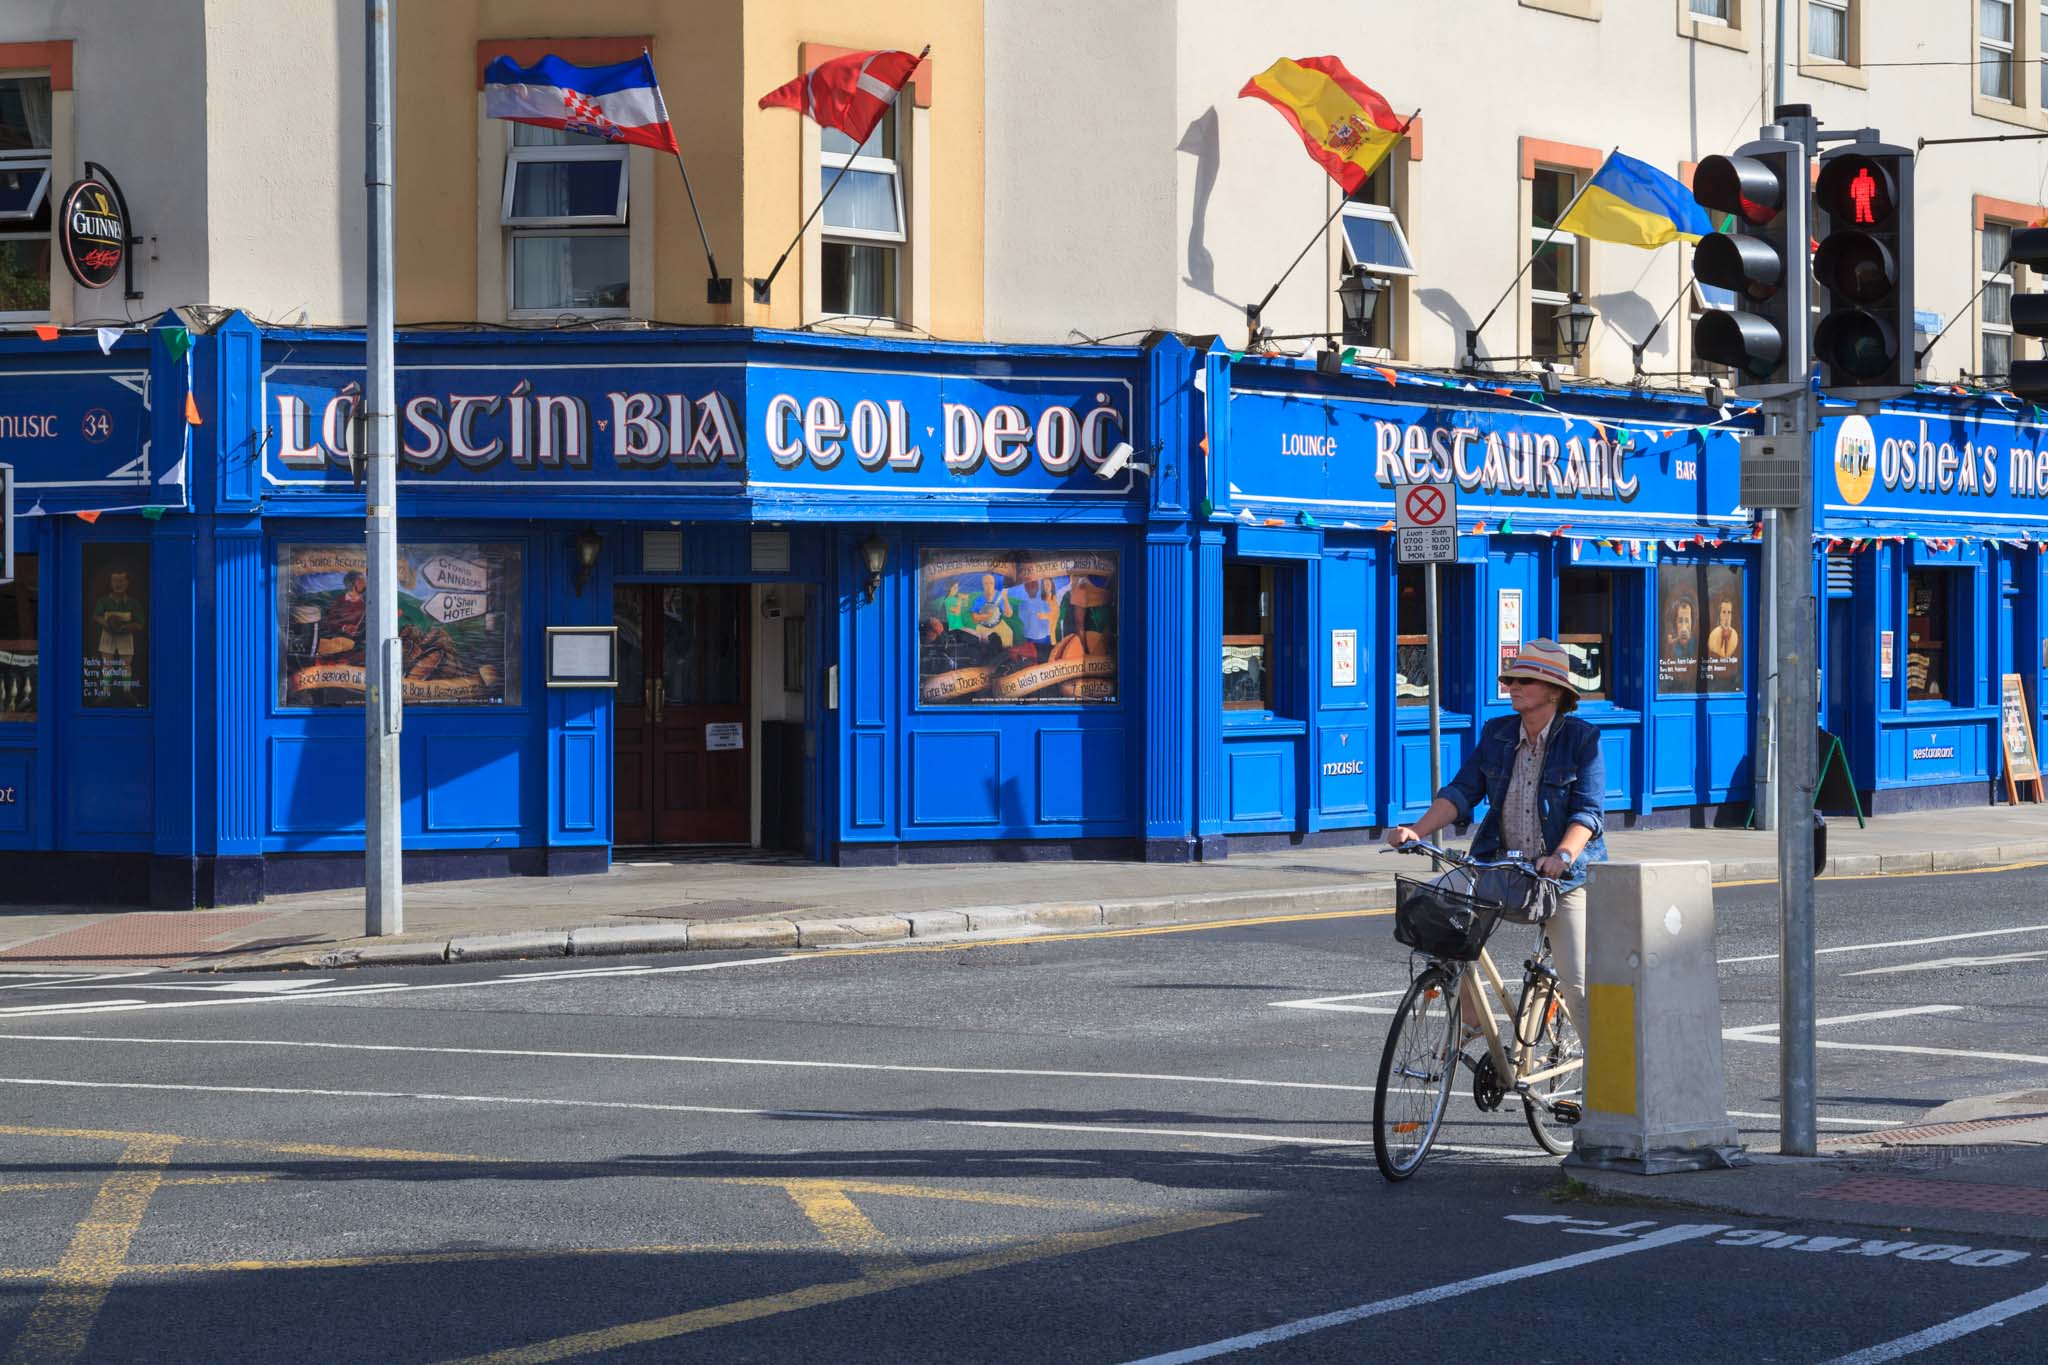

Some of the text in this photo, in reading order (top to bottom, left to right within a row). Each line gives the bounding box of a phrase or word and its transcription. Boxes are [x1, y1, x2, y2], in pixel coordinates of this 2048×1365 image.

[84, 414, 109, 437] 34
[608, 390, 741, 464] BIA
[1675, 459, 1697, 480] BAR
[443, 607, 476, 621] HOTEL
